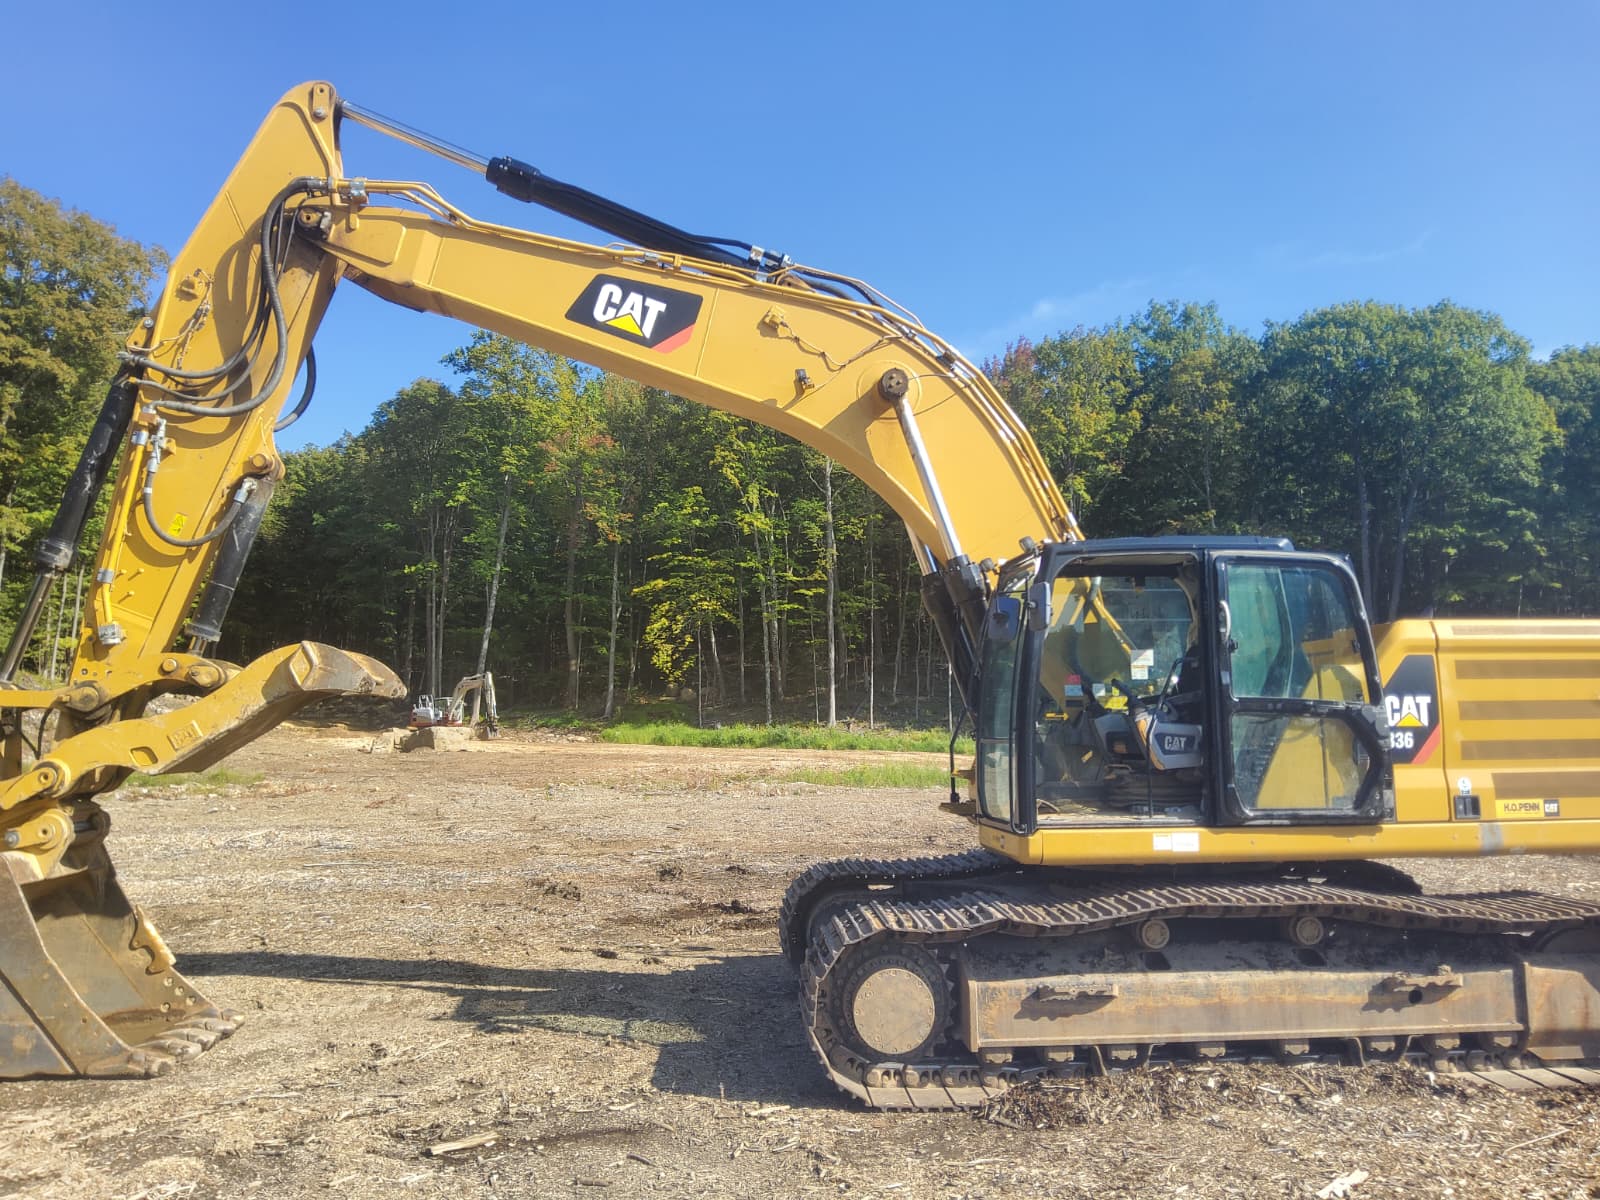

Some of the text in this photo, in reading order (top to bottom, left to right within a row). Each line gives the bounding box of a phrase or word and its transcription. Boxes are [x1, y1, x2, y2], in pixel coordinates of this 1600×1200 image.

[593, 283, 666, 339] CAT
[1385, 695, 1431, 727] CAT
[1164, 735, 1187, 751] CAT
